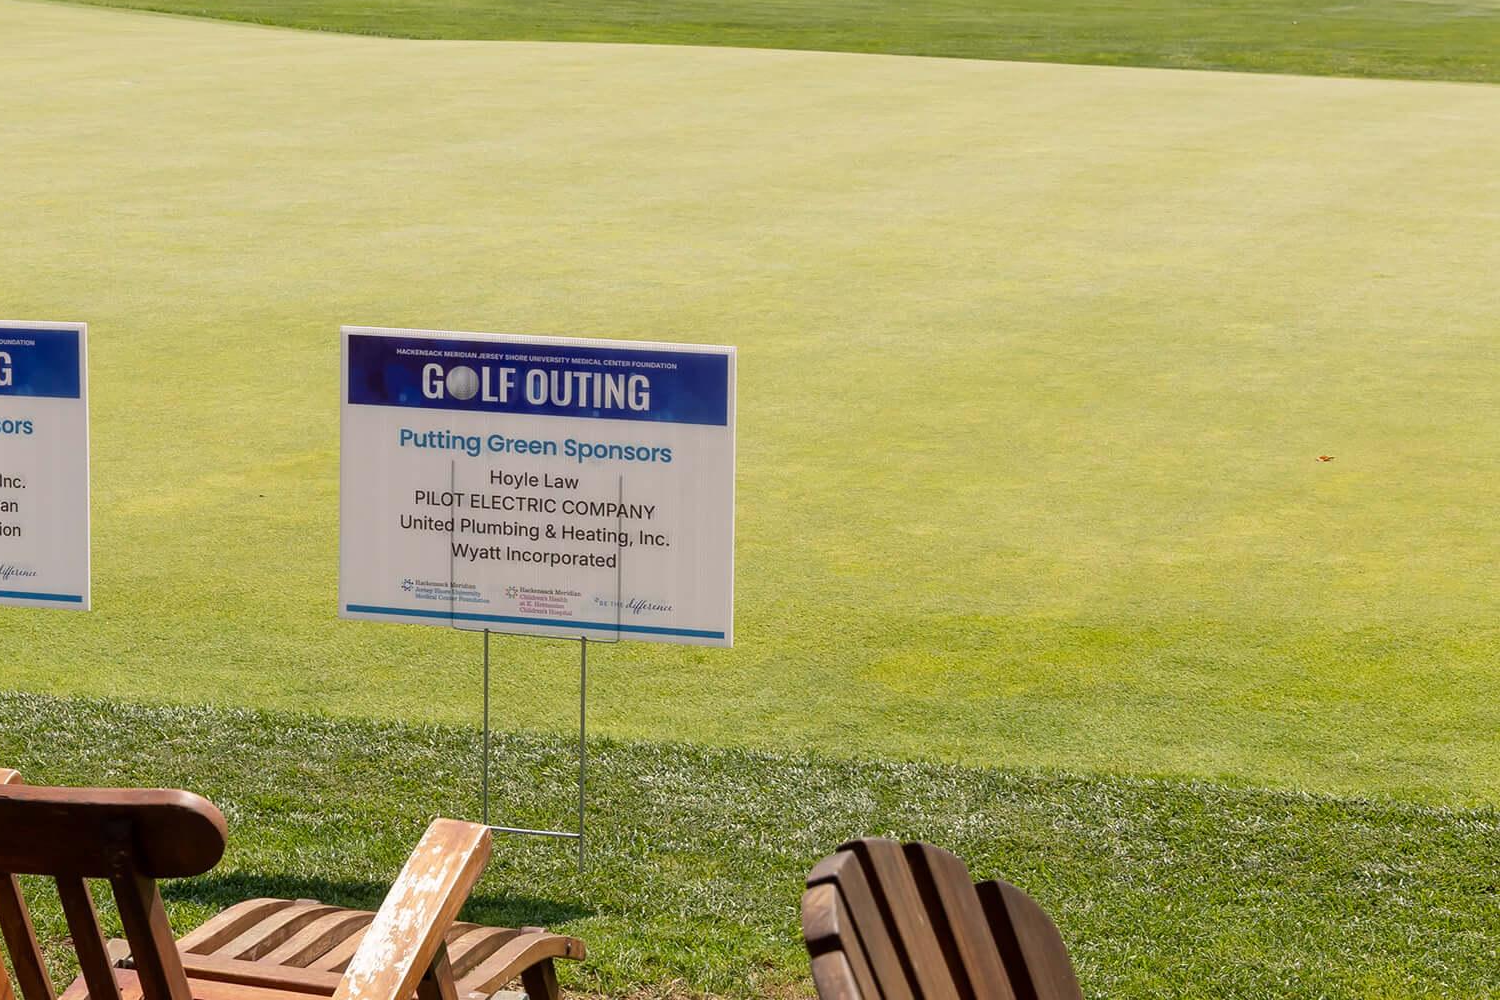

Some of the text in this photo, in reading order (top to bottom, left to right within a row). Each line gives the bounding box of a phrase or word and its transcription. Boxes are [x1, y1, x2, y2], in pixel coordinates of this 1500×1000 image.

[396, 348, 442, 357] HACKENSACK
[478, 352, 503, 360] JERSEY
[529, 355, 570, 363] UNIVERSITY
[571, 358, 601, 366] MEDICAL
[603, 359, 630, 367] CENTER
[632, 361, 677, 369] FOUNDATION
[526, 368, 650, 411] OUTING
[400, 429, 672, 463] Putting Green Sponsors
[0, 473, 26, 488] Inc.
[490, 470, 579, 489] Hoyle Law
[415, 490, 655, 519] PILOT ELECTRIC COMPANY
[400, 514, 670, 547] United Plumbing & Heating, Inc.
[451, 542, 616, 568] Wyatt Incorporated
